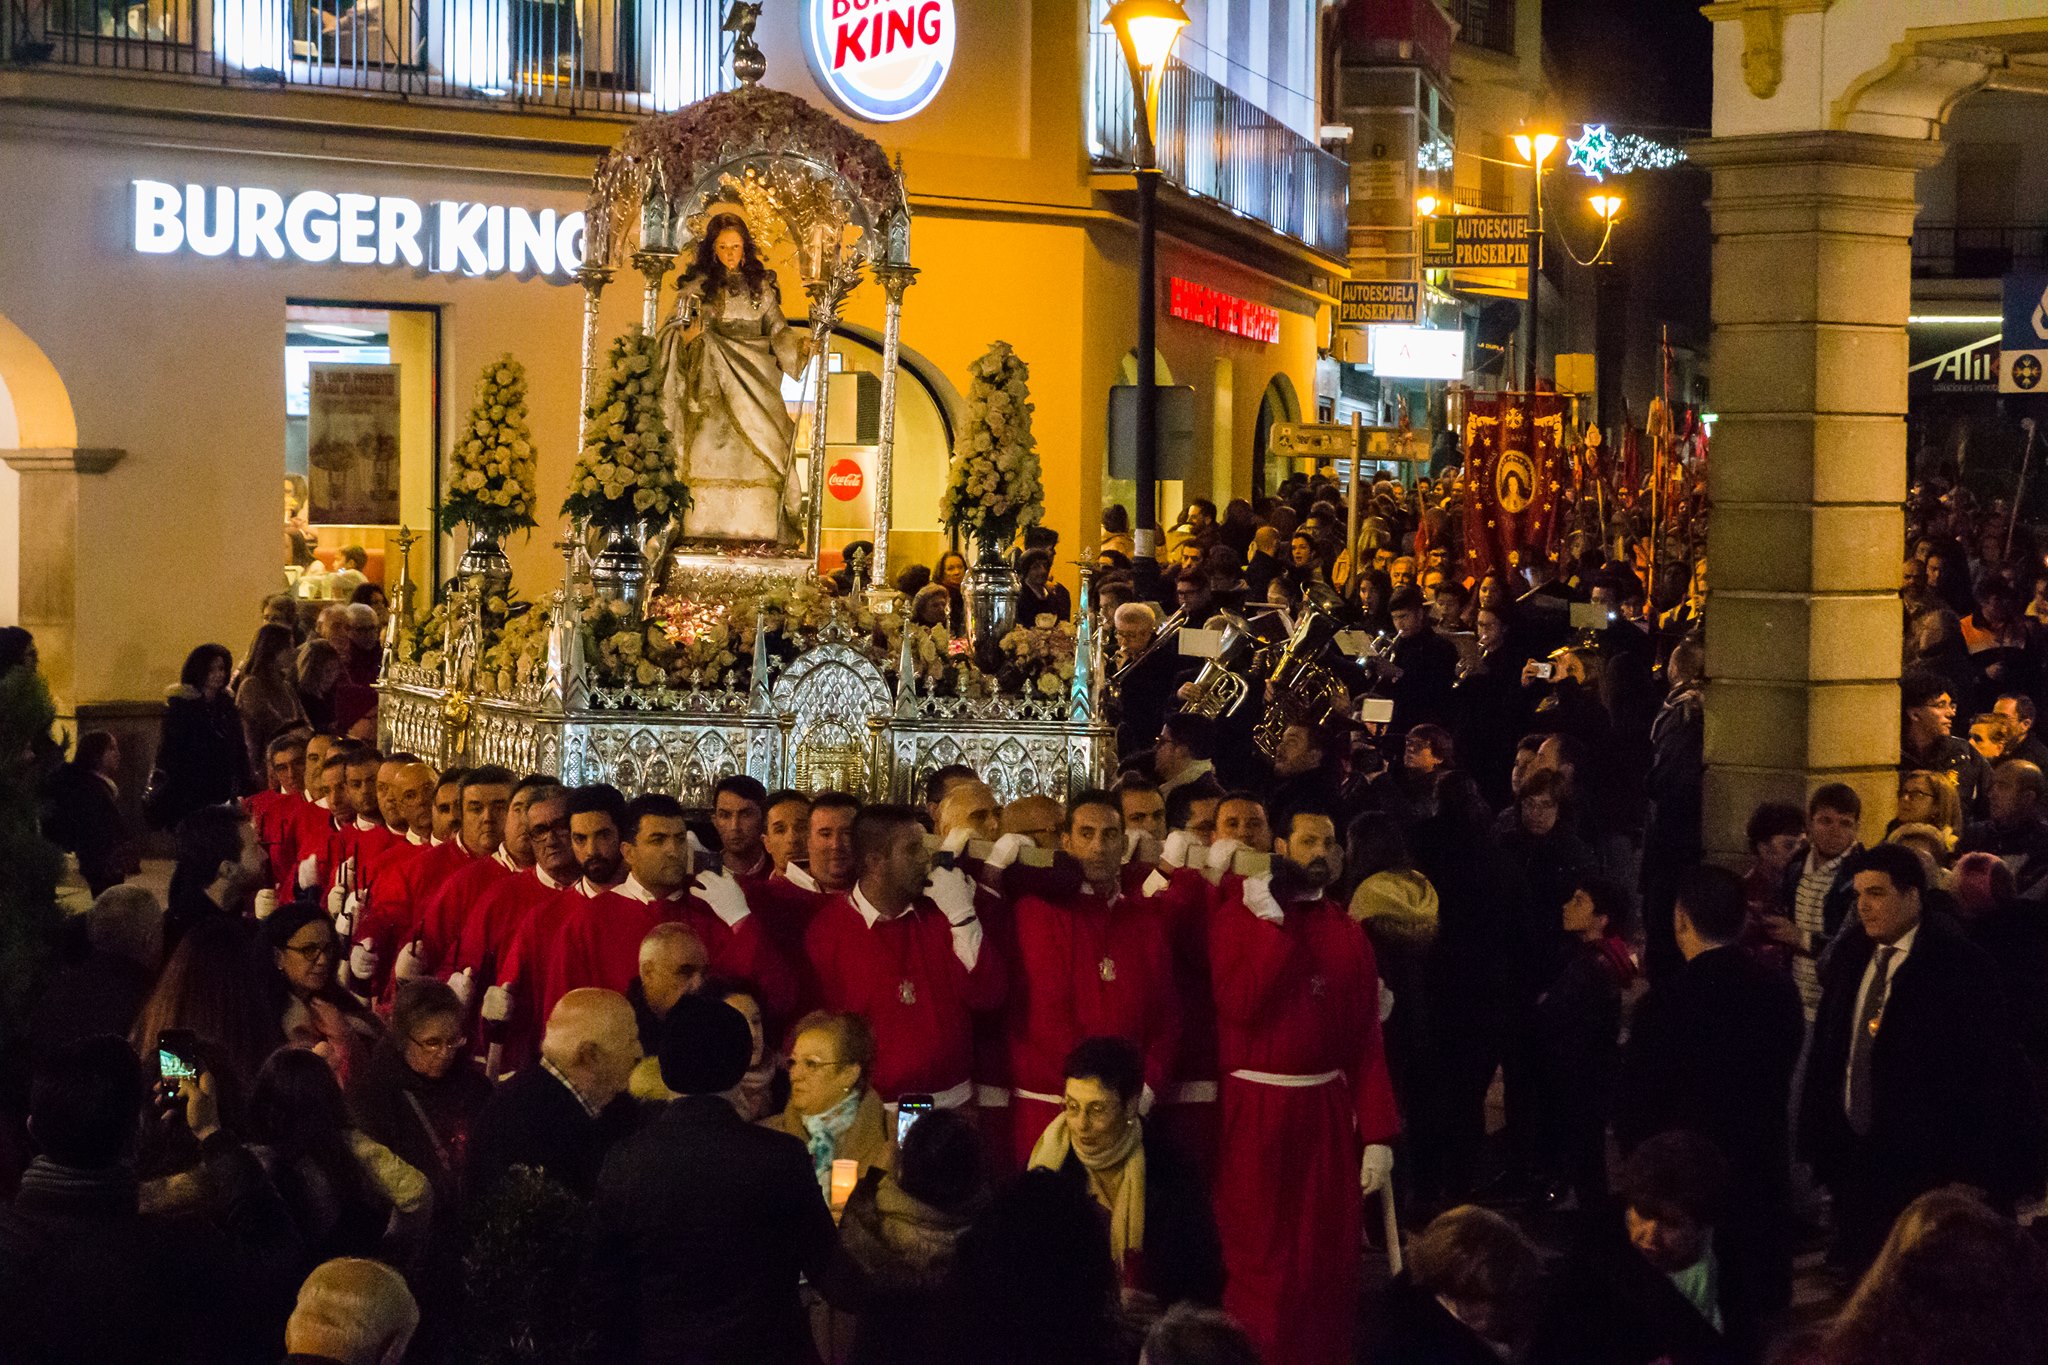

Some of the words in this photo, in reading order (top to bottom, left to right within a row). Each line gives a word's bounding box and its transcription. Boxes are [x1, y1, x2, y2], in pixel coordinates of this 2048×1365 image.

[834, 1, 941, 69] KING
[133, 179, 424, 266] BURGER
[1342, 303, 1414, 321] PROSERPINA
[1343, 285, 1415, 302] AUTOESCUELA
